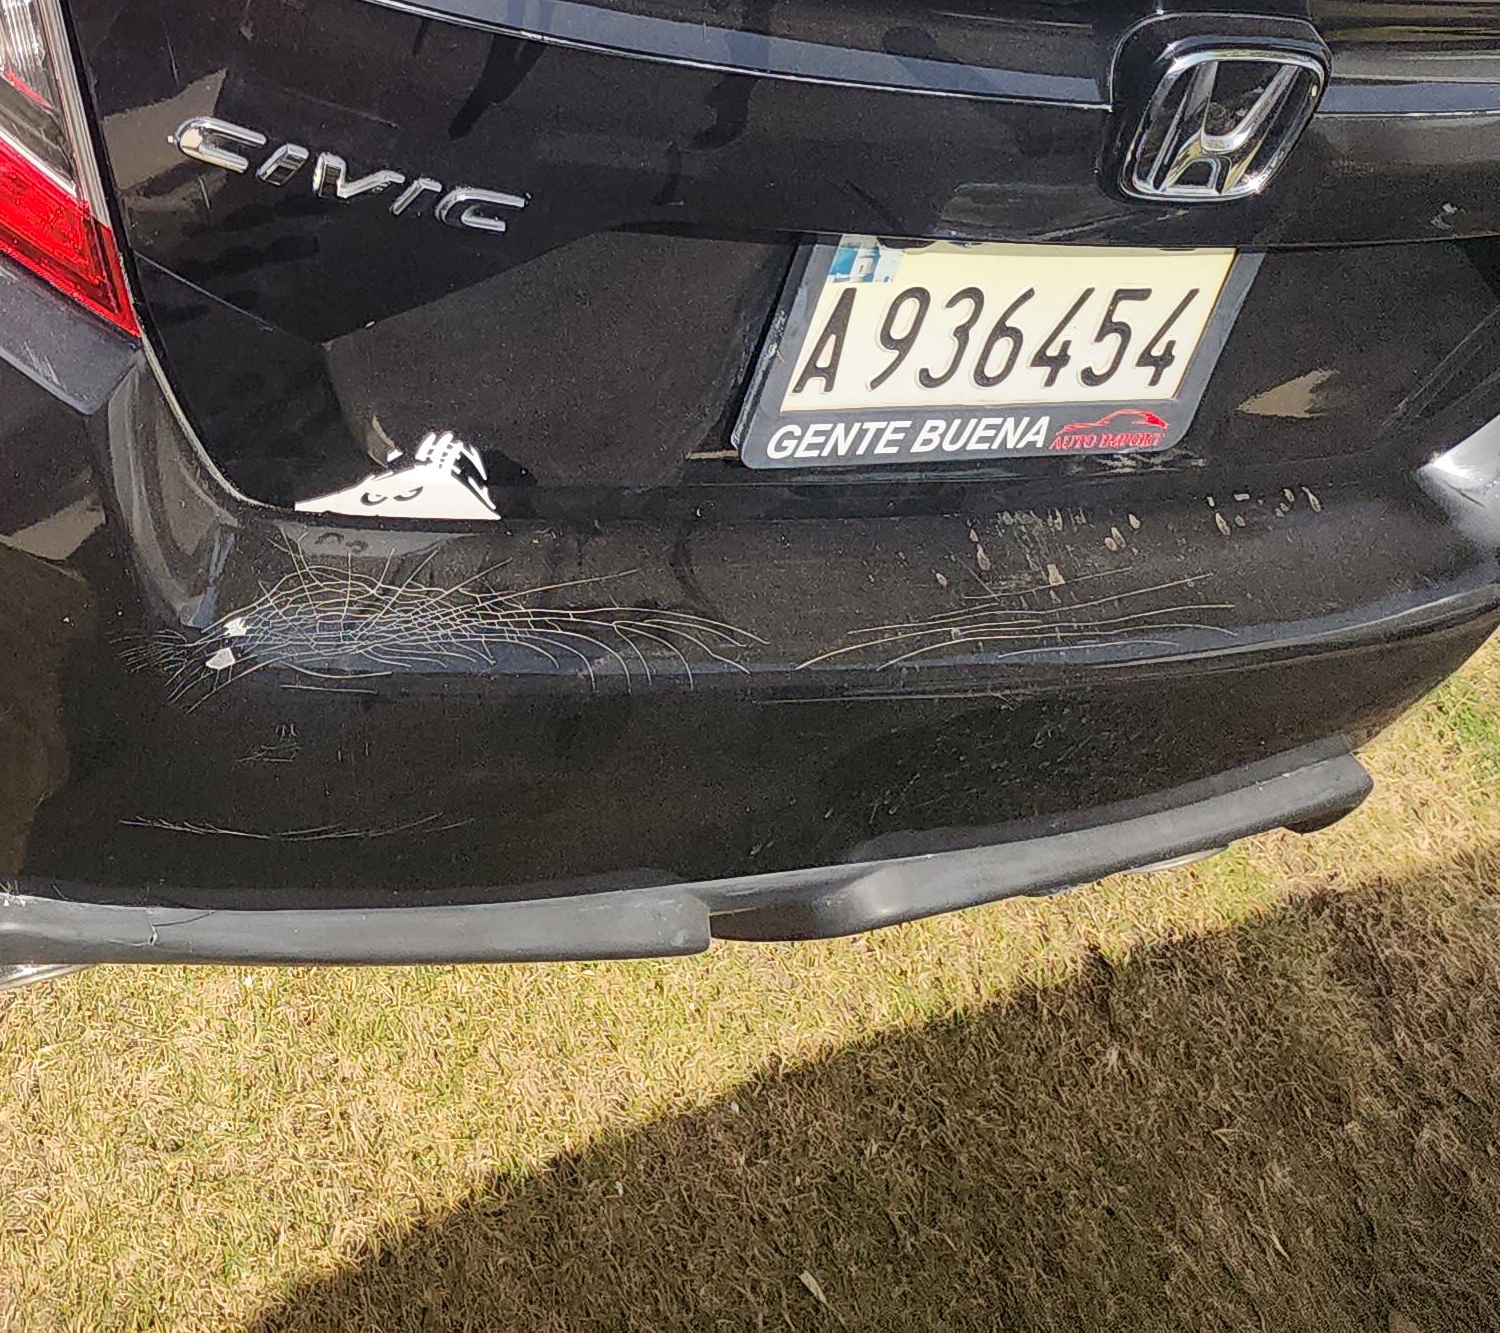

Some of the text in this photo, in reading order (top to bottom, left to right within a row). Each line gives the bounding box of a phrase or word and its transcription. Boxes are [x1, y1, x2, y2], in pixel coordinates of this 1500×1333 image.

[168, 115, 528, 234] CIVIC
[766, 415, 1166, 460] GENTE BUENA AUTO IMPORT
